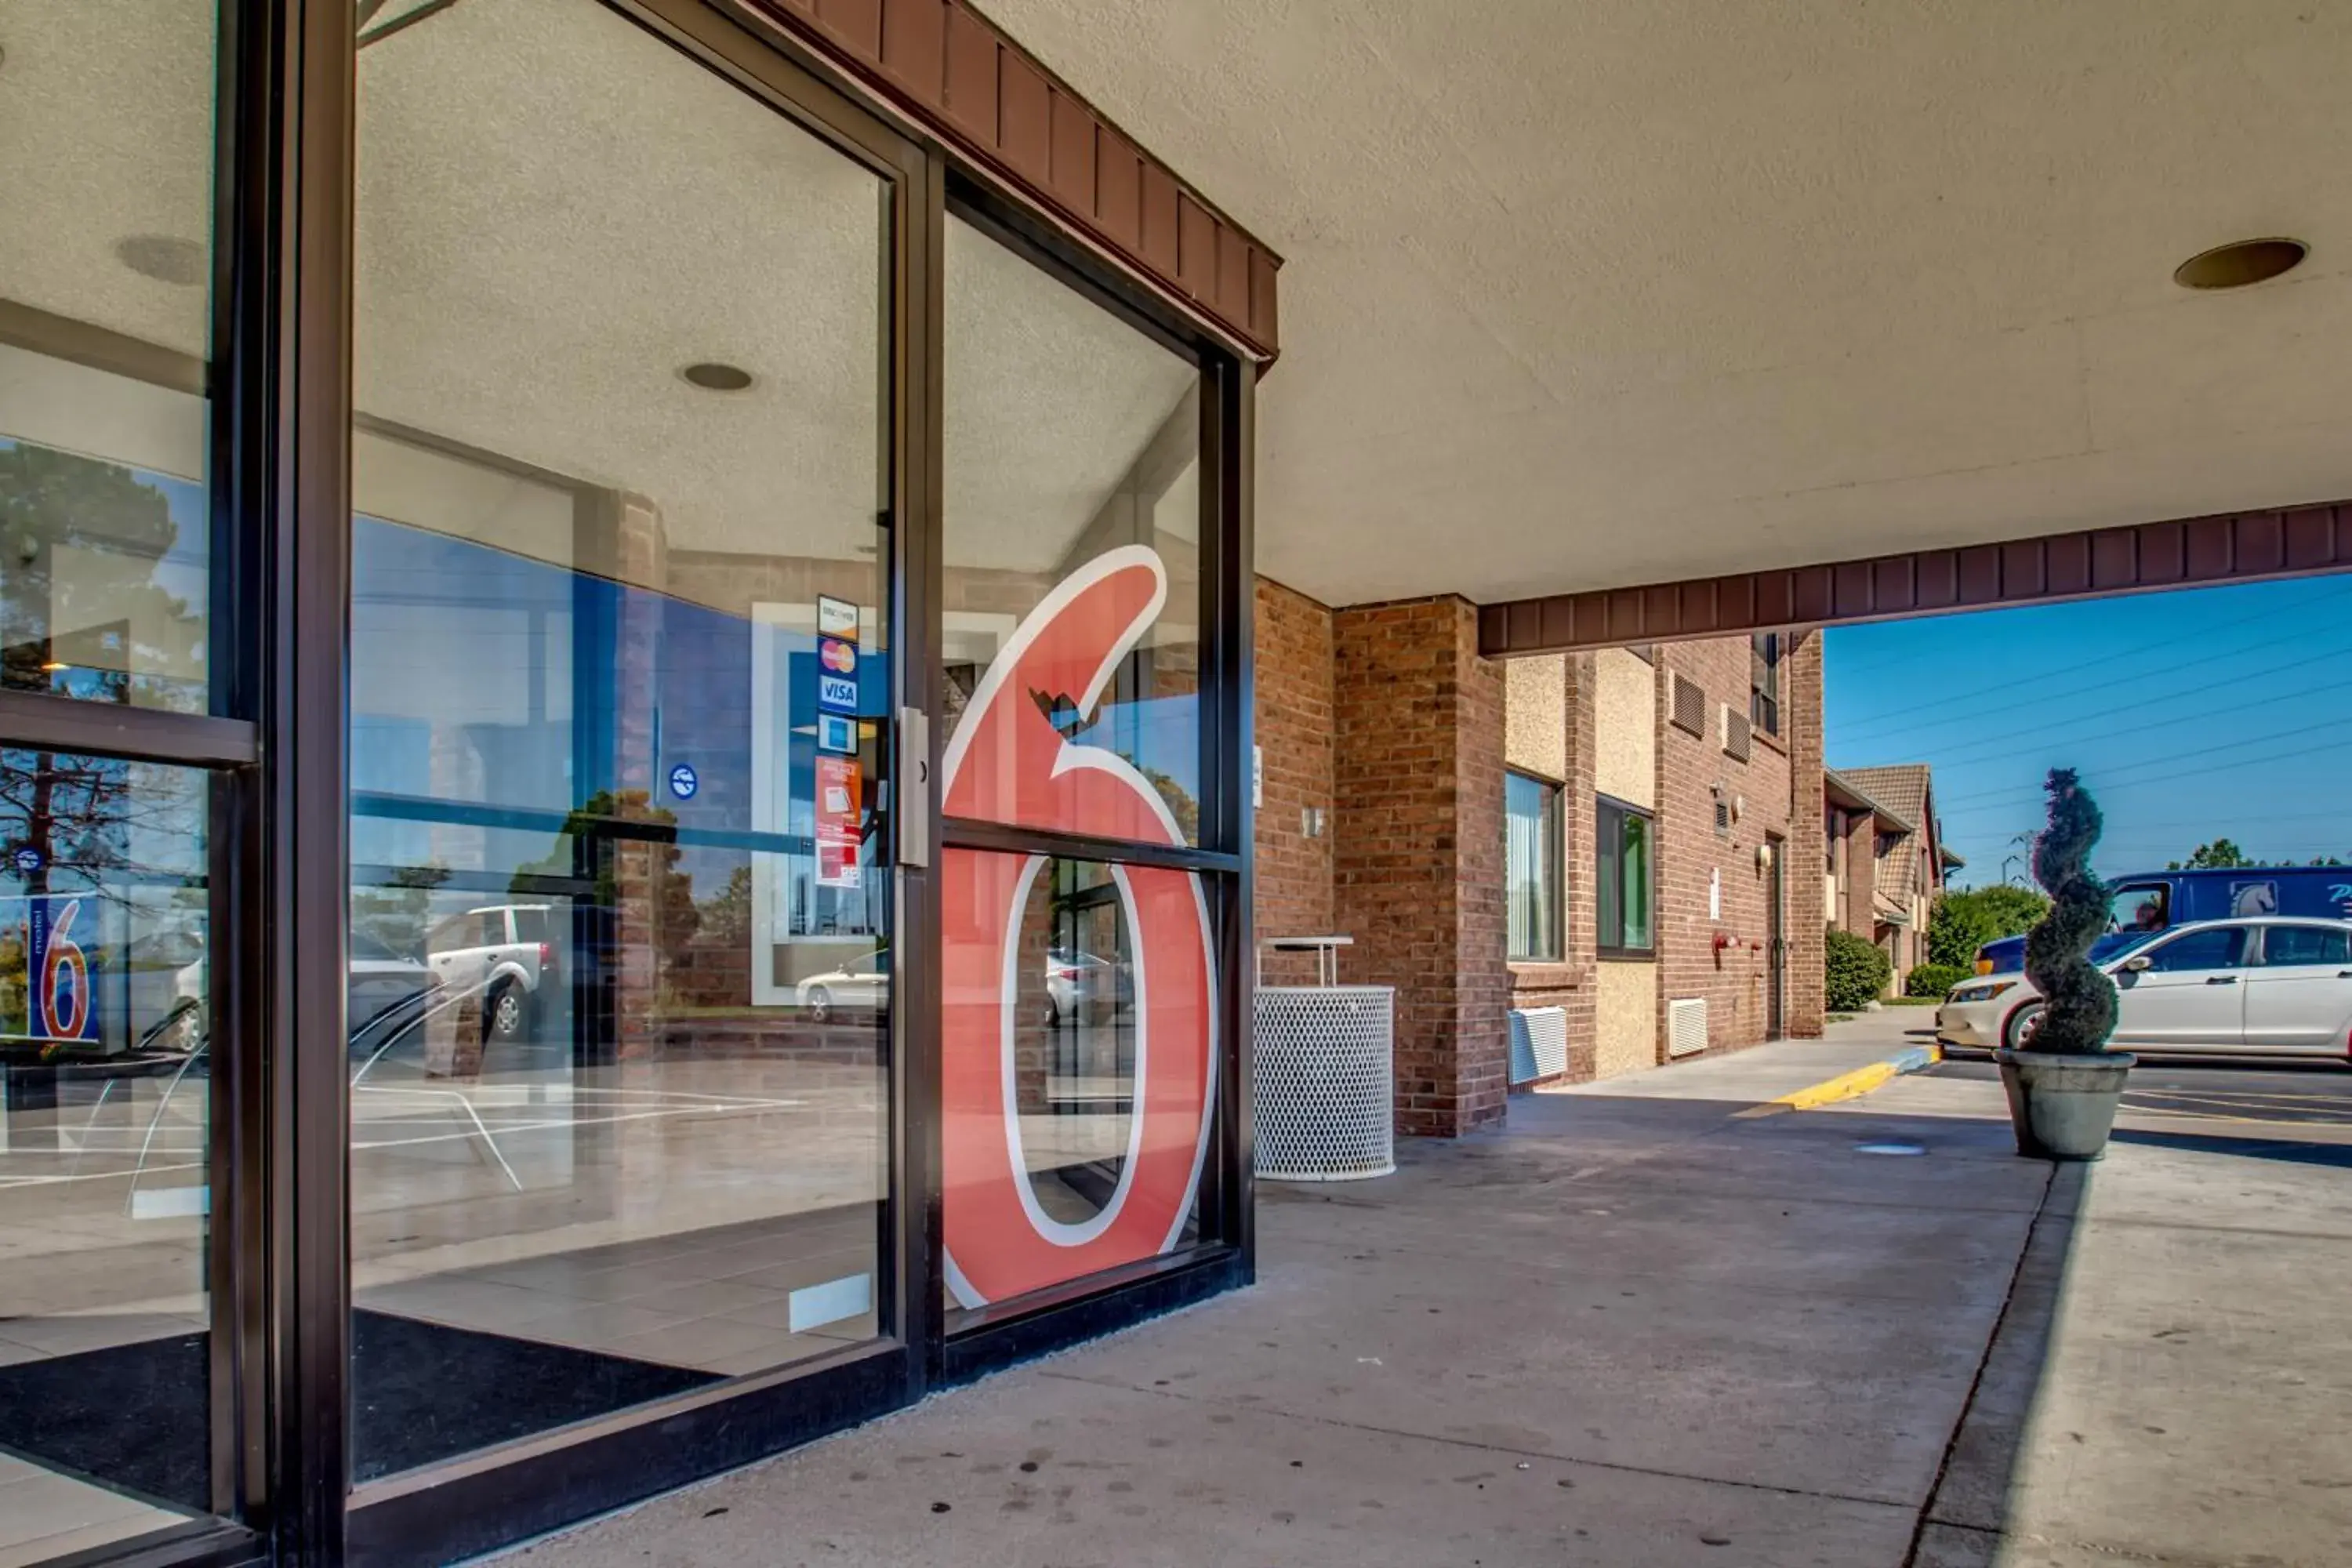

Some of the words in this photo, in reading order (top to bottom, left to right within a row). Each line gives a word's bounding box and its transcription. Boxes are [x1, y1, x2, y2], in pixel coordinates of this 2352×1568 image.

[825, 683, 854, 702] VISA
[41, 898, 90, 1040] 6
[941, 543, 1218, 1310] 6
